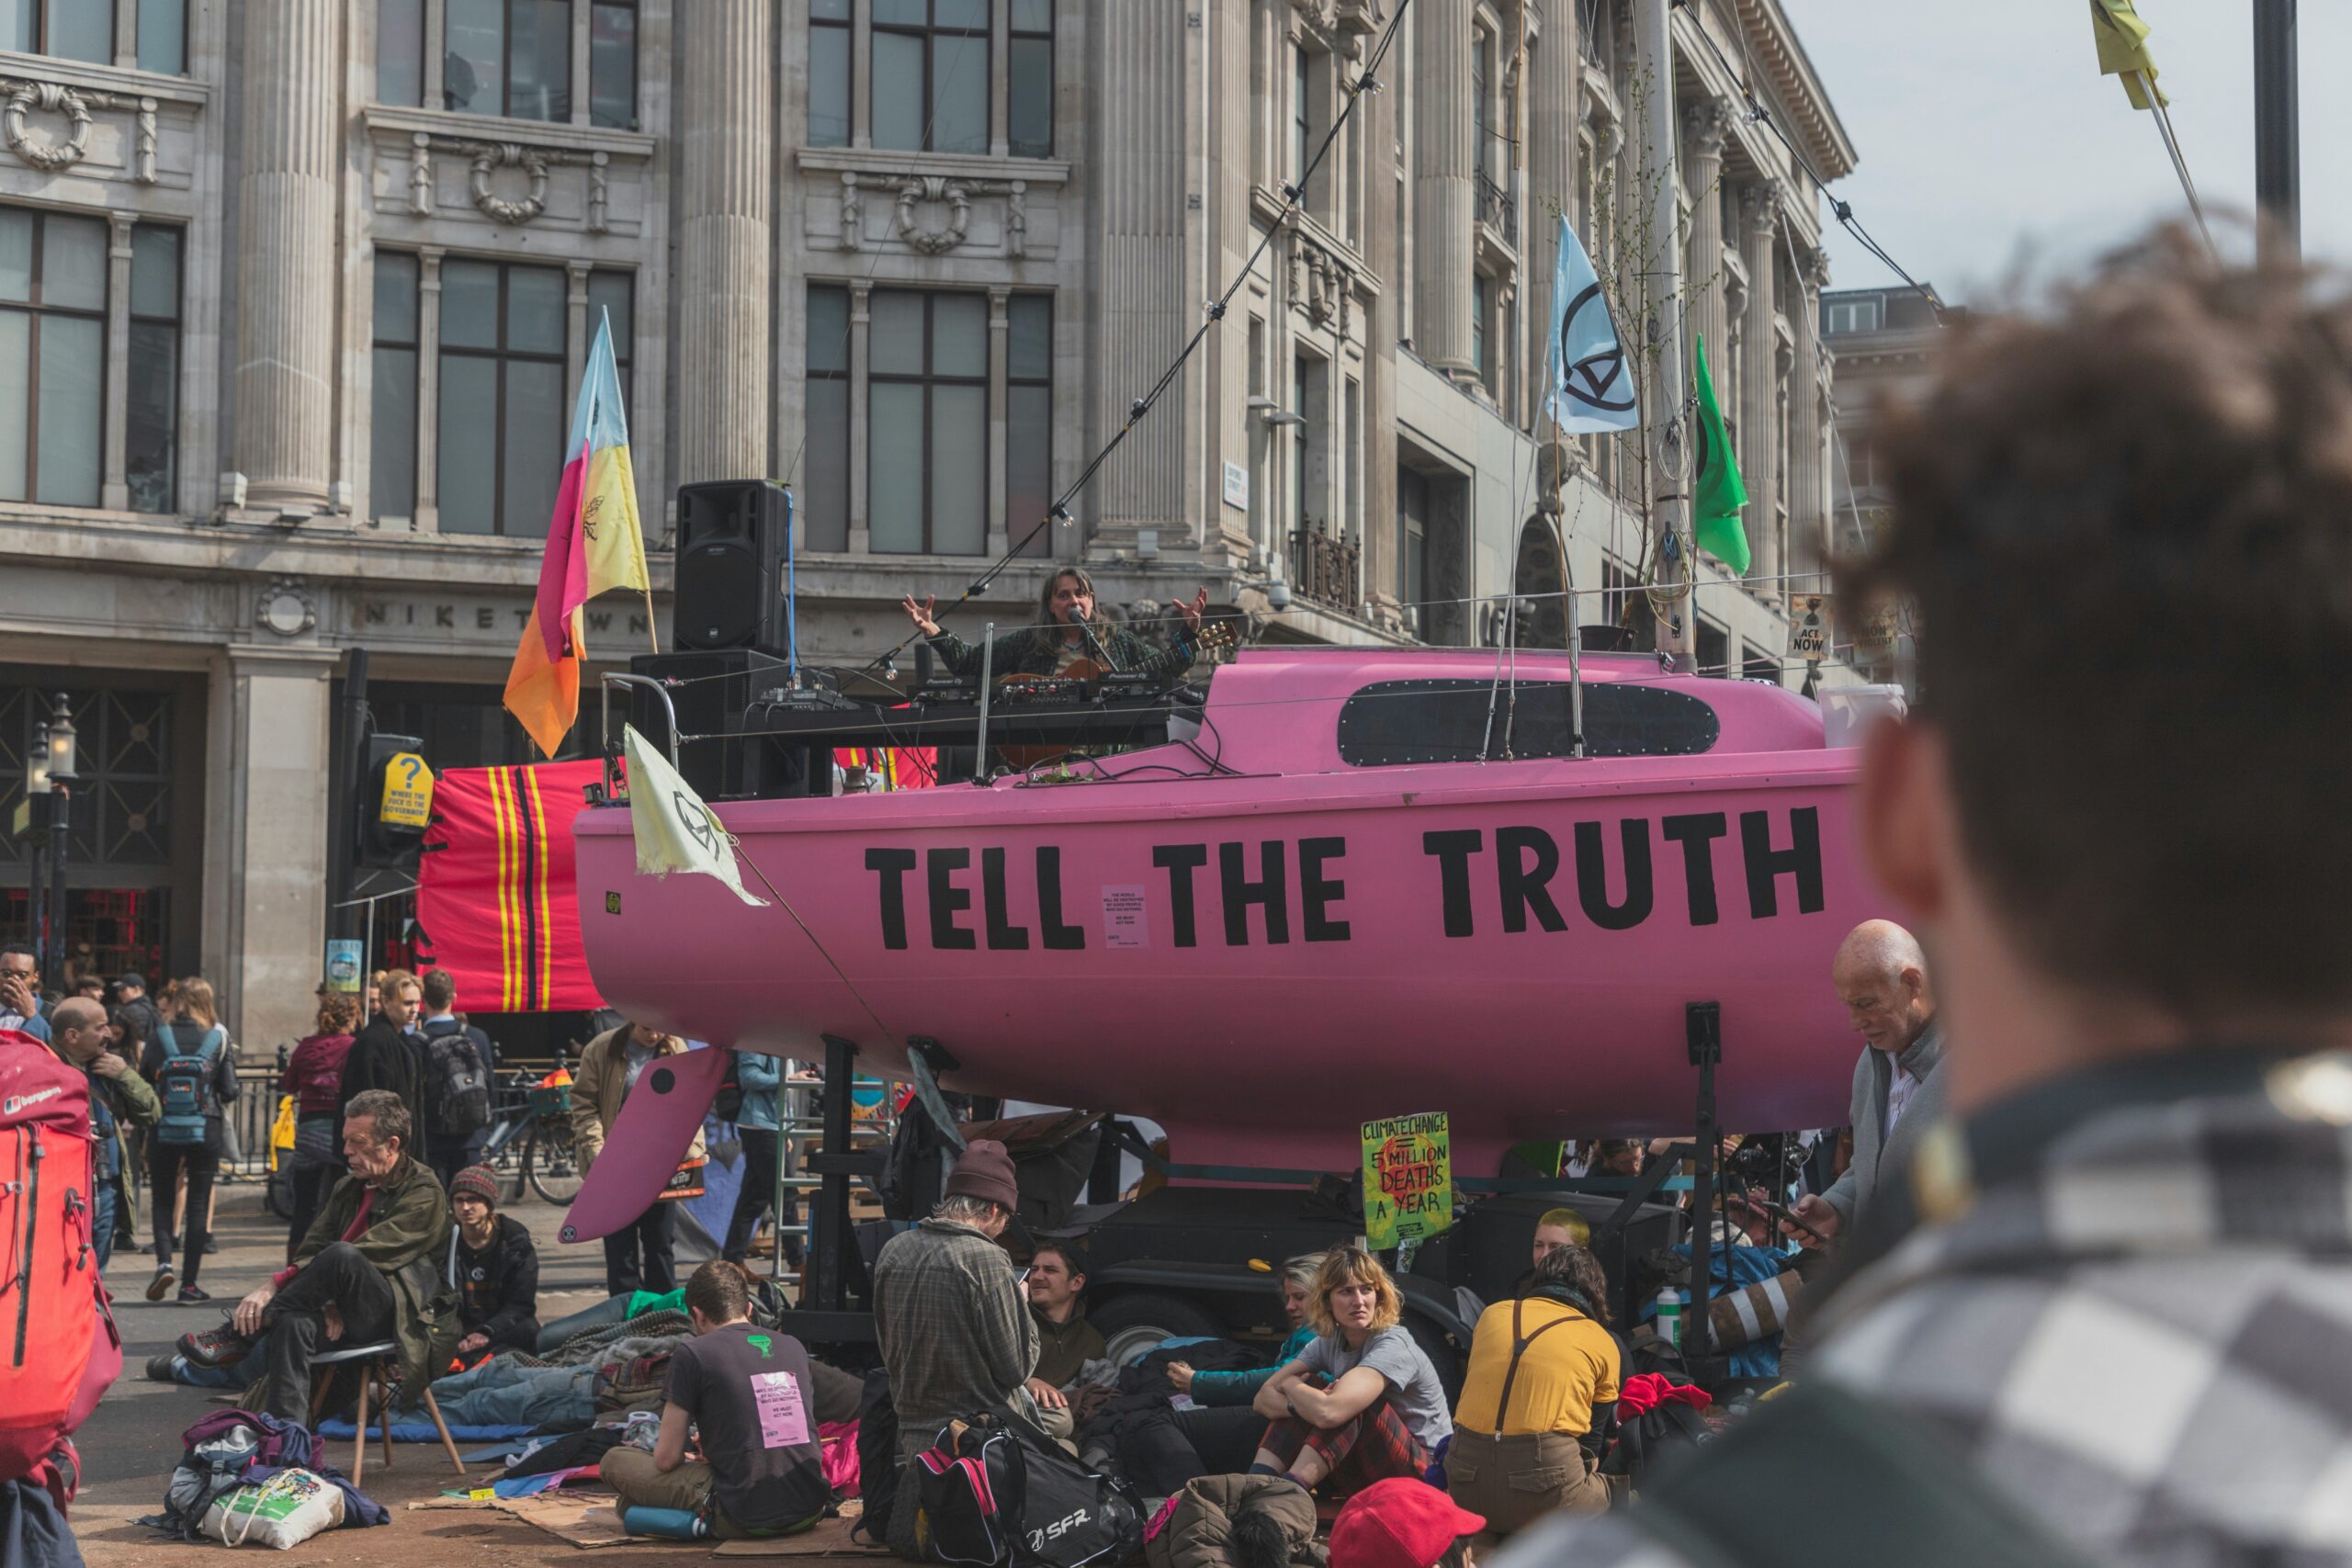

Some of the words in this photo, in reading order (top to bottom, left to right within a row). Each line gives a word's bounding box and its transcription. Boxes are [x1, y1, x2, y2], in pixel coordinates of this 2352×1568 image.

[366, 603, 649, 633] NIKETWN
[1793, 638, 1824, 651] NOW
[1801, 629, 1818, 638] ACT
[865, 847, 1085, 950] TELL
[1153, 837, 1351, 947] THE
[1423, 807, 1824, 937] TRUTH
[1372, 1151, 1385, 1168] 5
[1389, 1145, 1446, 1167] MILLION
[1382, 1165, 1443, 1193] DEATHS
[1376, 1201, 1386, 1220] A
[1396, 1191, 1440, 1217] YEAR
